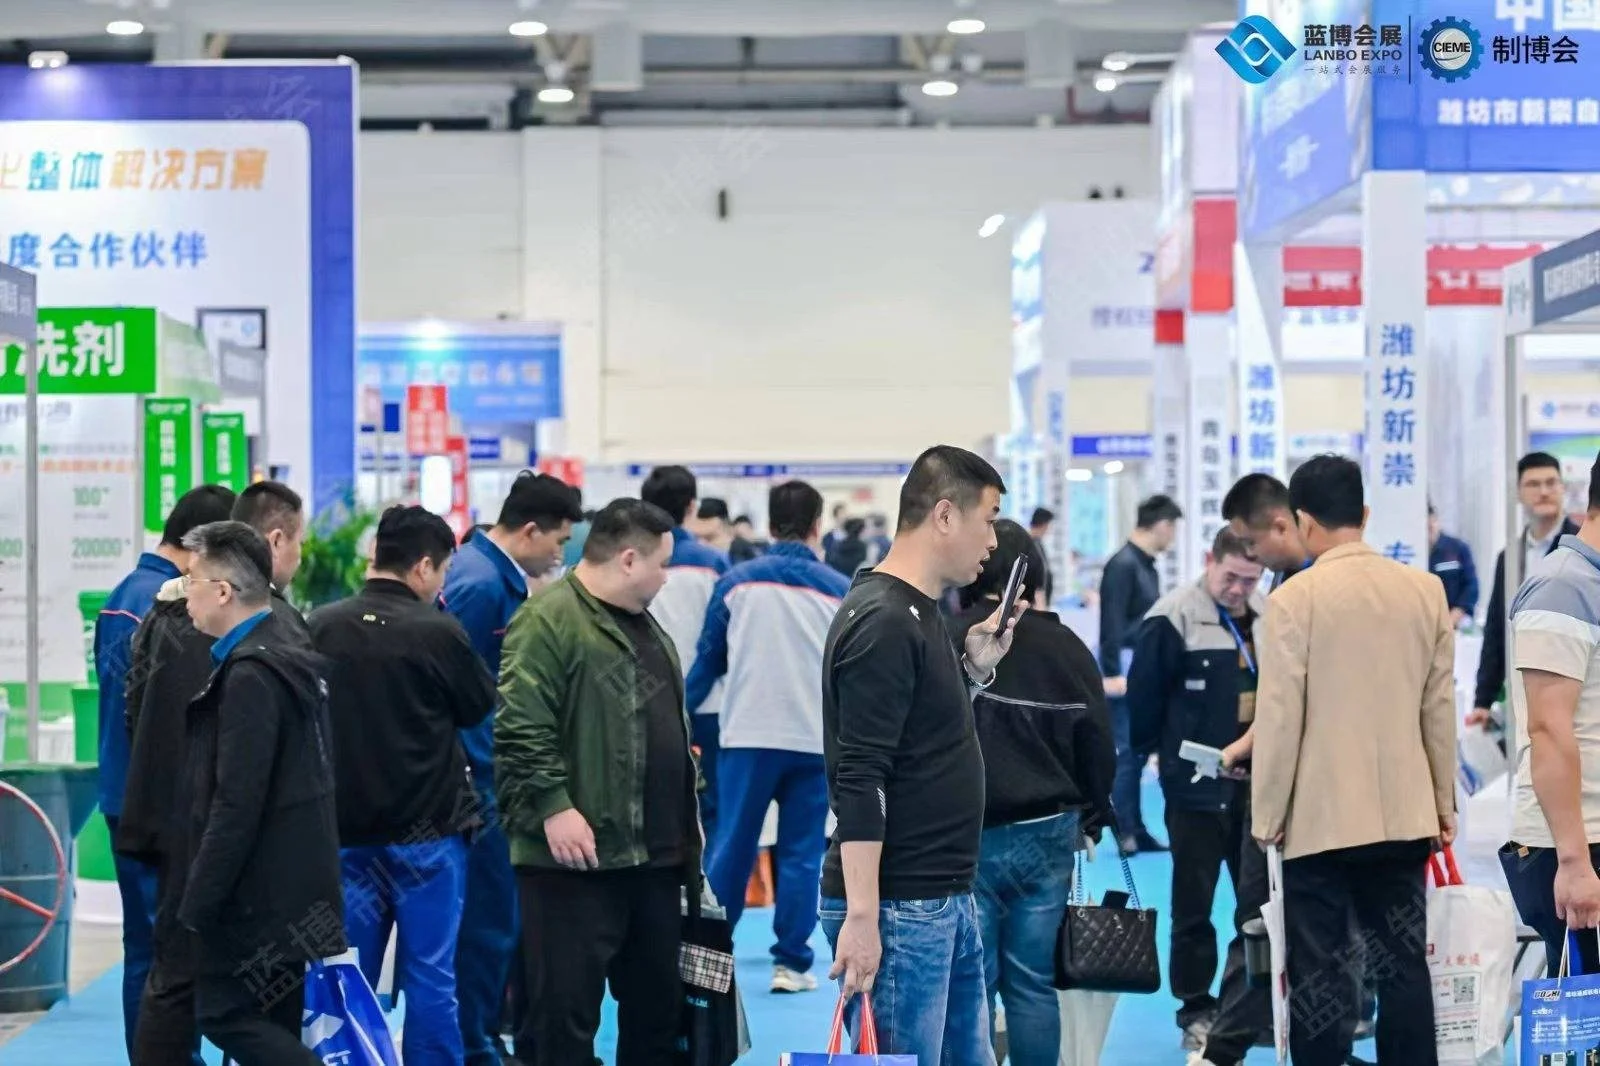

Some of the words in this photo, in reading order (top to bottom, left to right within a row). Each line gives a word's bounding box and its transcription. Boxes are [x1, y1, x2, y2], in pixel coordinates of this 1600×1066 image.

[0, 231, 208, 268] 度合作伙伴
[0, 319, 125, 377] 洗剂
[1383, 323, 1416, 486] 潍坊新崇
